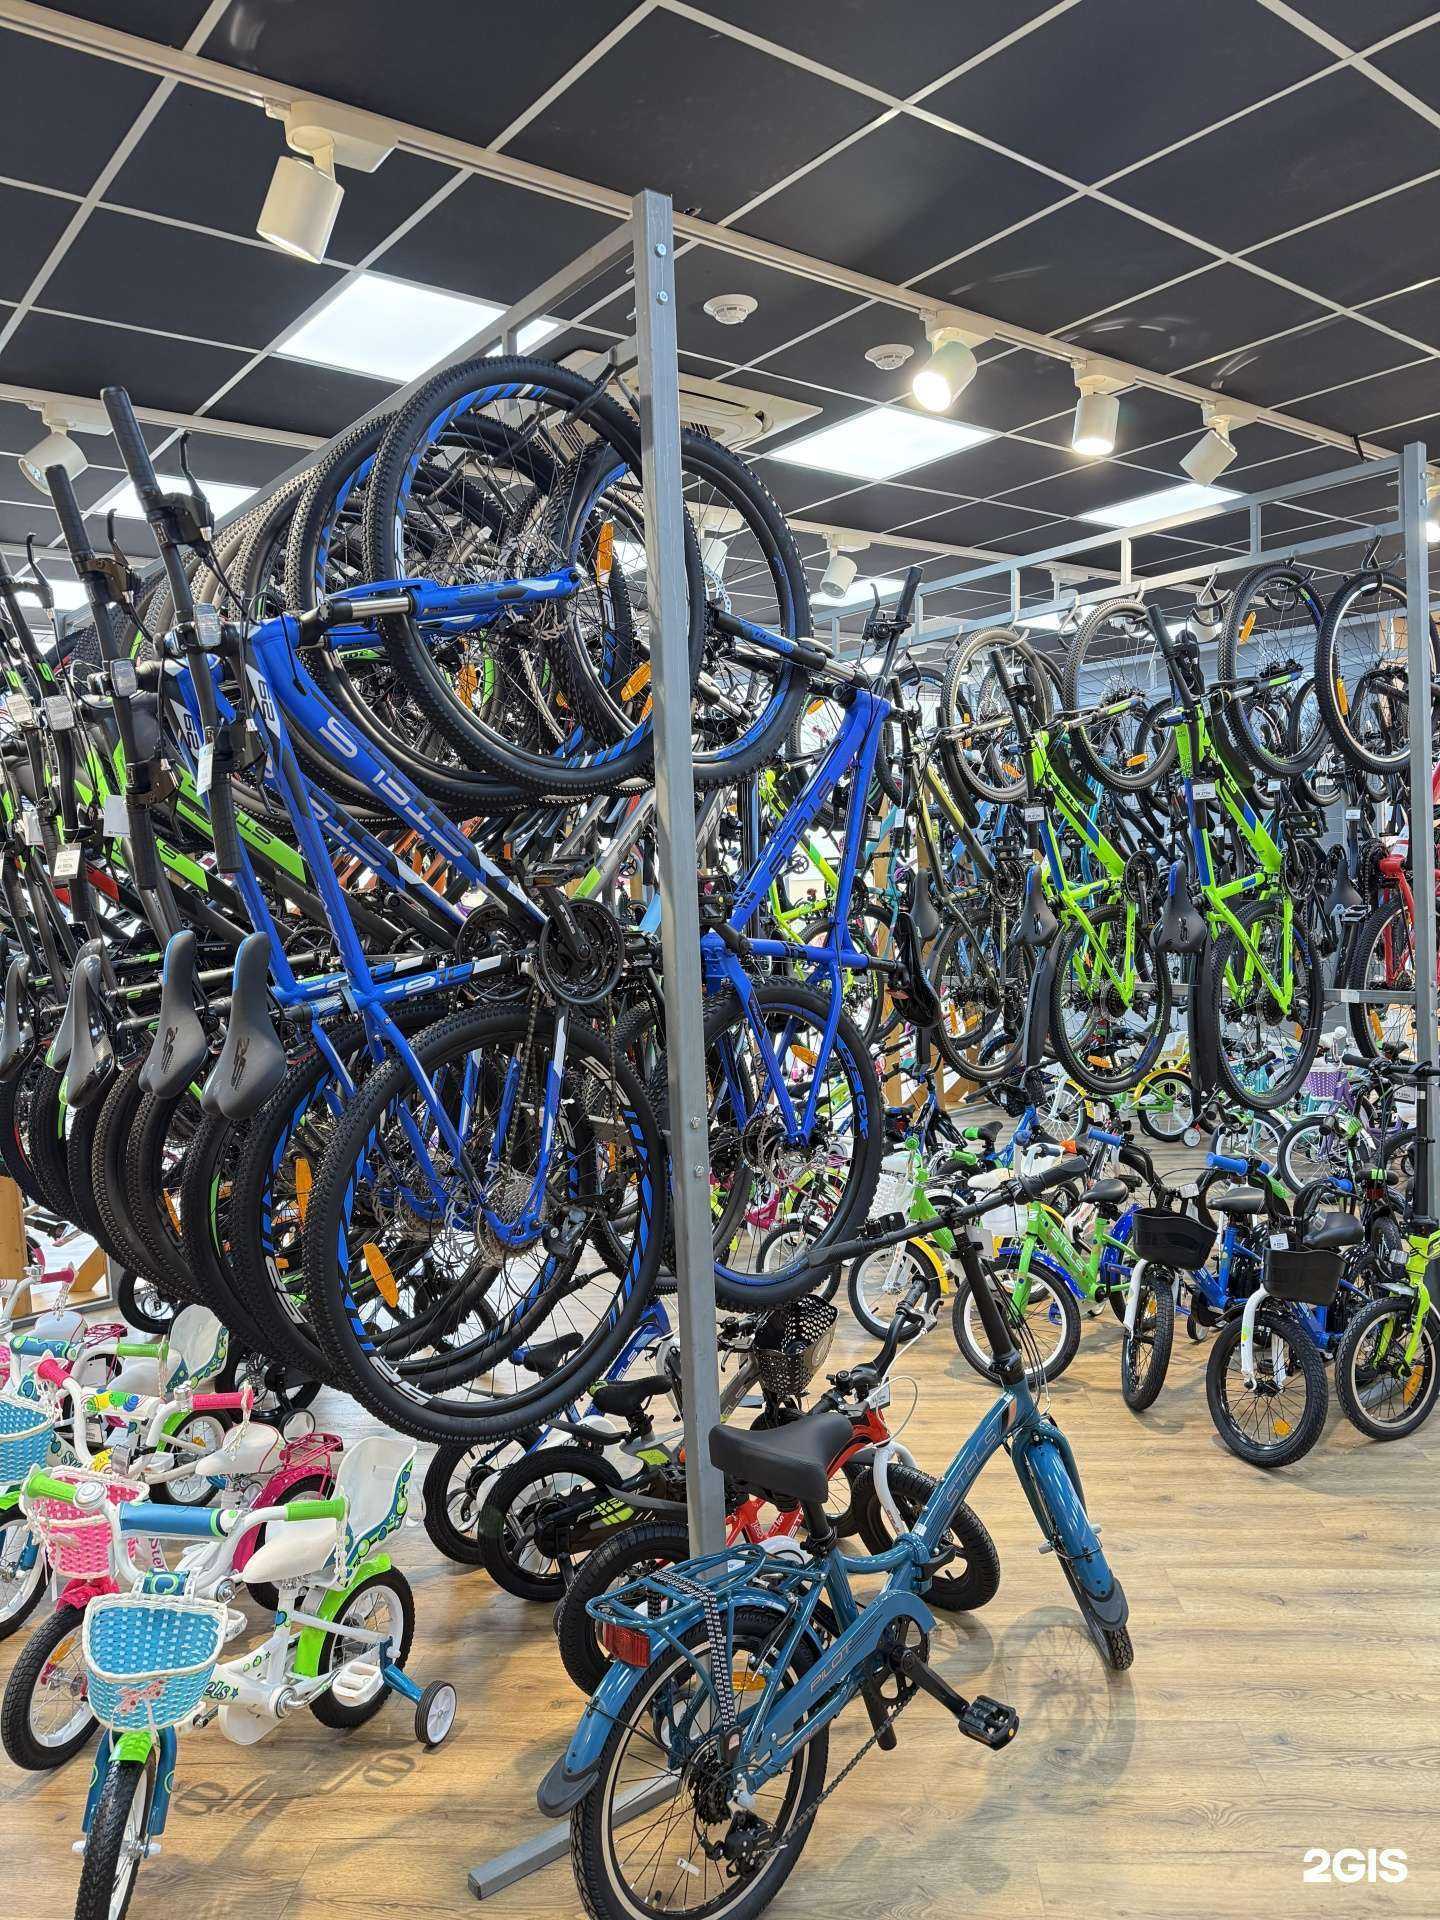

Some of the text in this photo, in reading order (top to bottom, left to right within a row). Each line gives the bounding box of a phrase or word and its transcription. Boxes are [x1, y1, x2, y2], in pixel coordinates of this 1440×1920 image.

[319, 716, 472, 857] STELS
[614, 1350, 639, 1381] ELS
[944, 1427, 997, 1505] STELS
[204, 1680, 231, 1700] els
[809, 1639, 851, 1696] PILOT
